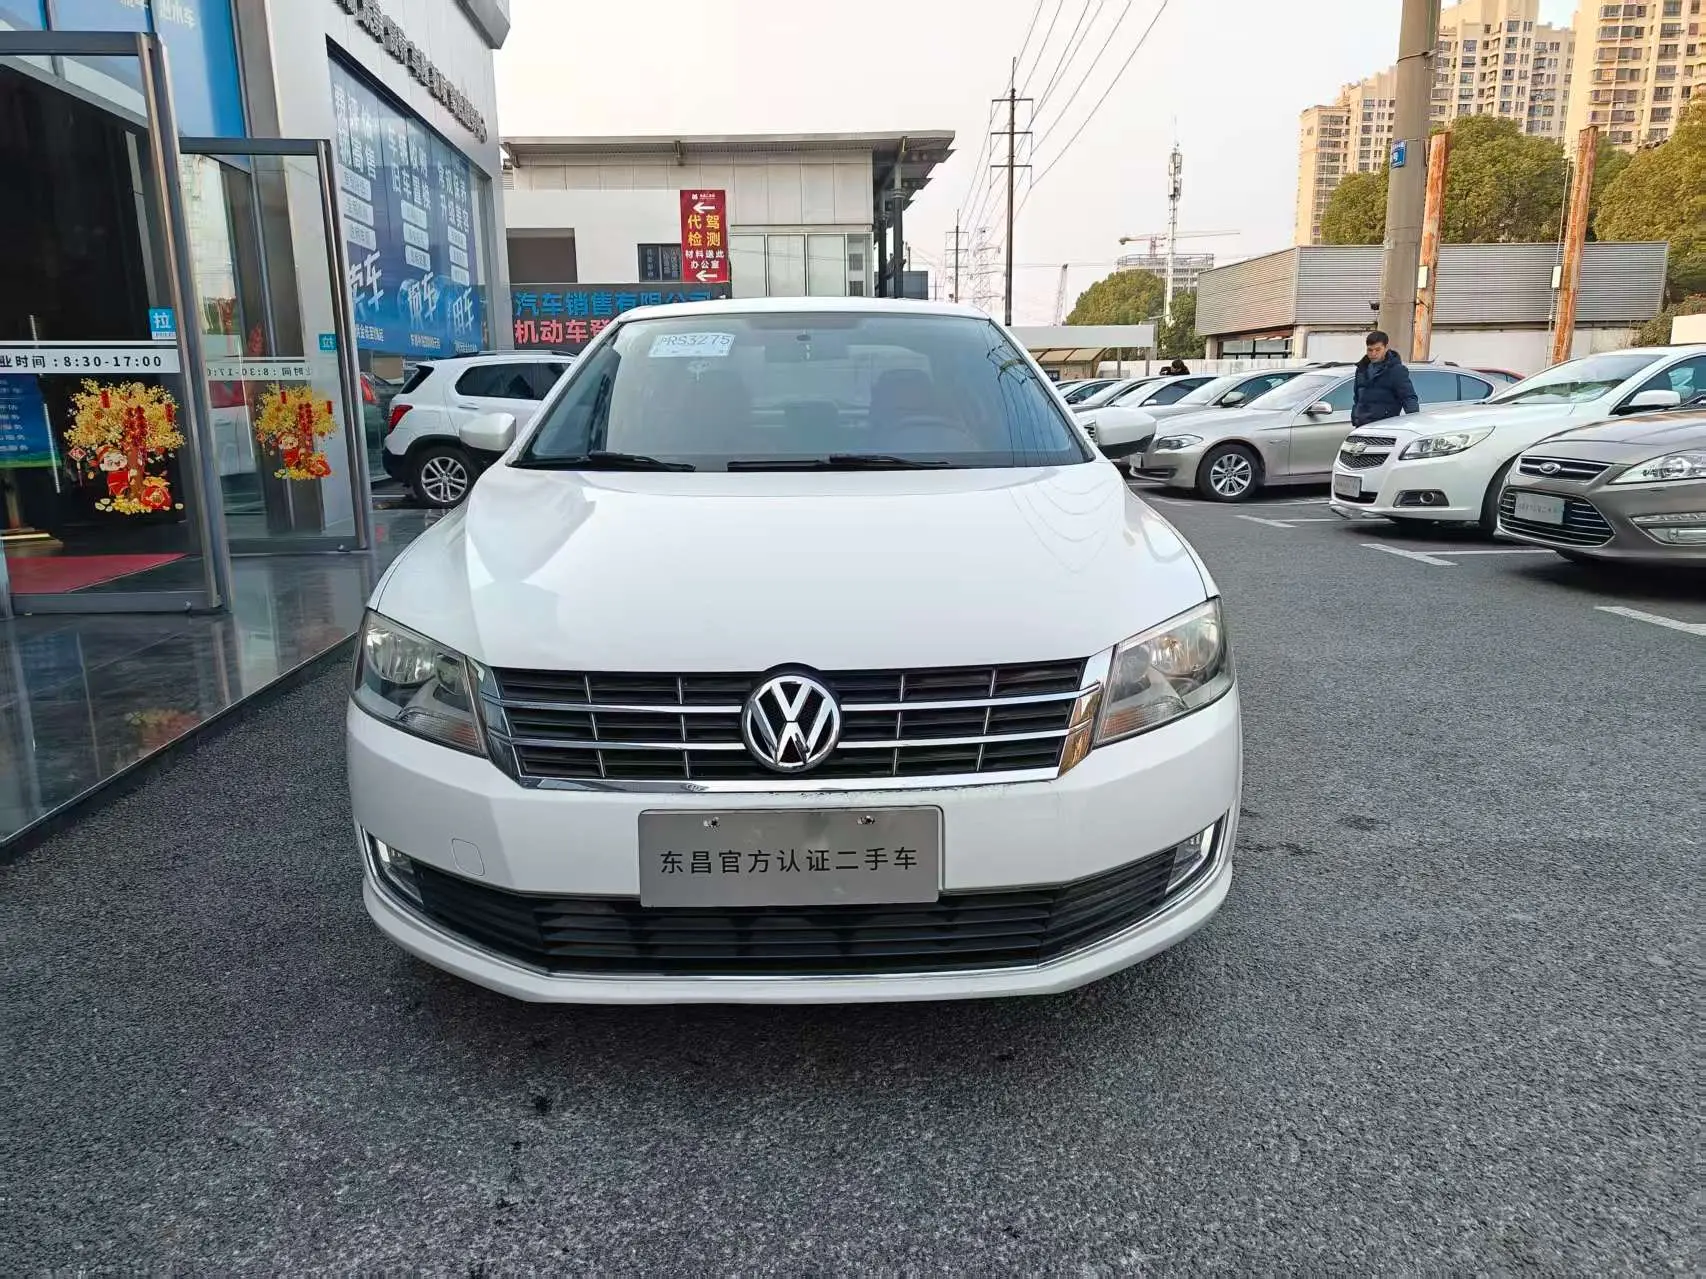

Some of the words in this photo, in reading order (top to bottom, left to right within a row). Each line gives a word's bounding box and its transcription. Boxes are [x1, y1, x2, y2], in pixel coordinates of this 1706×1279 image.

[687, 214, 720, 230] 代驾
[687, 231, 721, 247] 检测
[685, 250, 725, 259] 材料送此
[690, 260, 720, 269] 办公室
[153, 312, 172, 329] 拉
[659, 846, 919, 875] 东昌官方认证二手车
